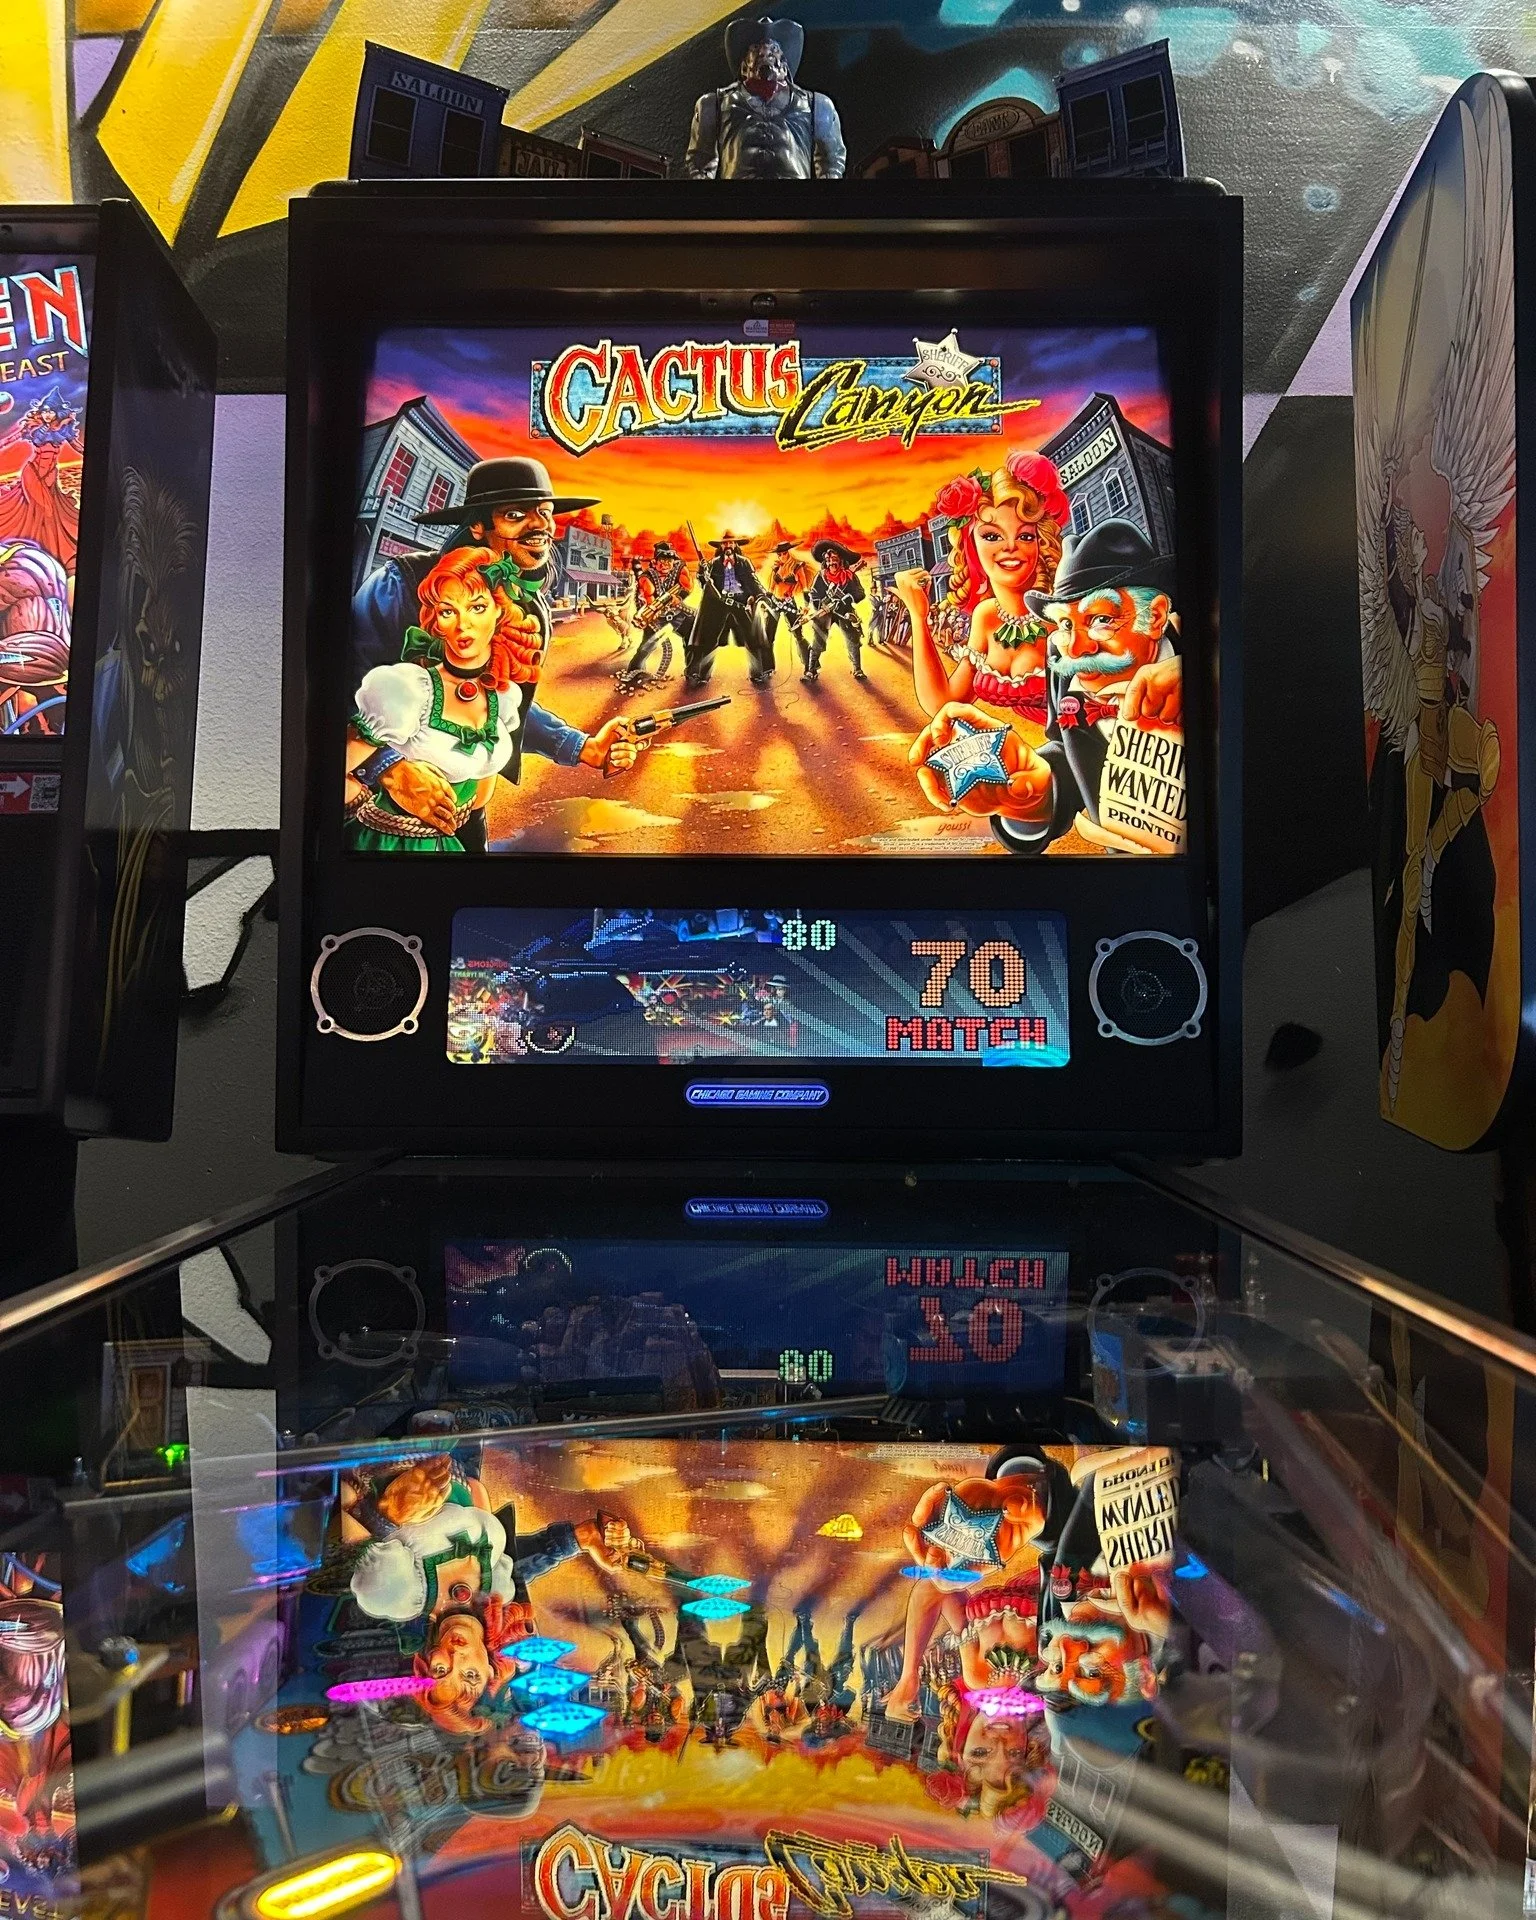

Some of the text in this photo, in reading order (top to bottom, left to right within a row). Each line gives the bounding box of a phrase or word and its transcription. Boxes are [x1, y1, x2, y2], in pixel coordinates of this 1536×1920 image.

[393, 72, 481, 114] SALOON
[922, 349, 969, 370] SHERIFF
[545, 339, 1040, 456] CACTUS Canyon
[1060, 430, 1114, 485] SALOON
[572, 530, 608, 549] JAIL
[1108, 763, 1187, 821] WANTED
[1108, 807, 1181, 844] PRONTO!
[782, 919, 836, 951] 80
[911, 941, 1025, 1006] 70
[887, 1017, 1046, 1050] MATCH
[690, 1089, 825, 1100] CHICAGO GAMING COMPANY
